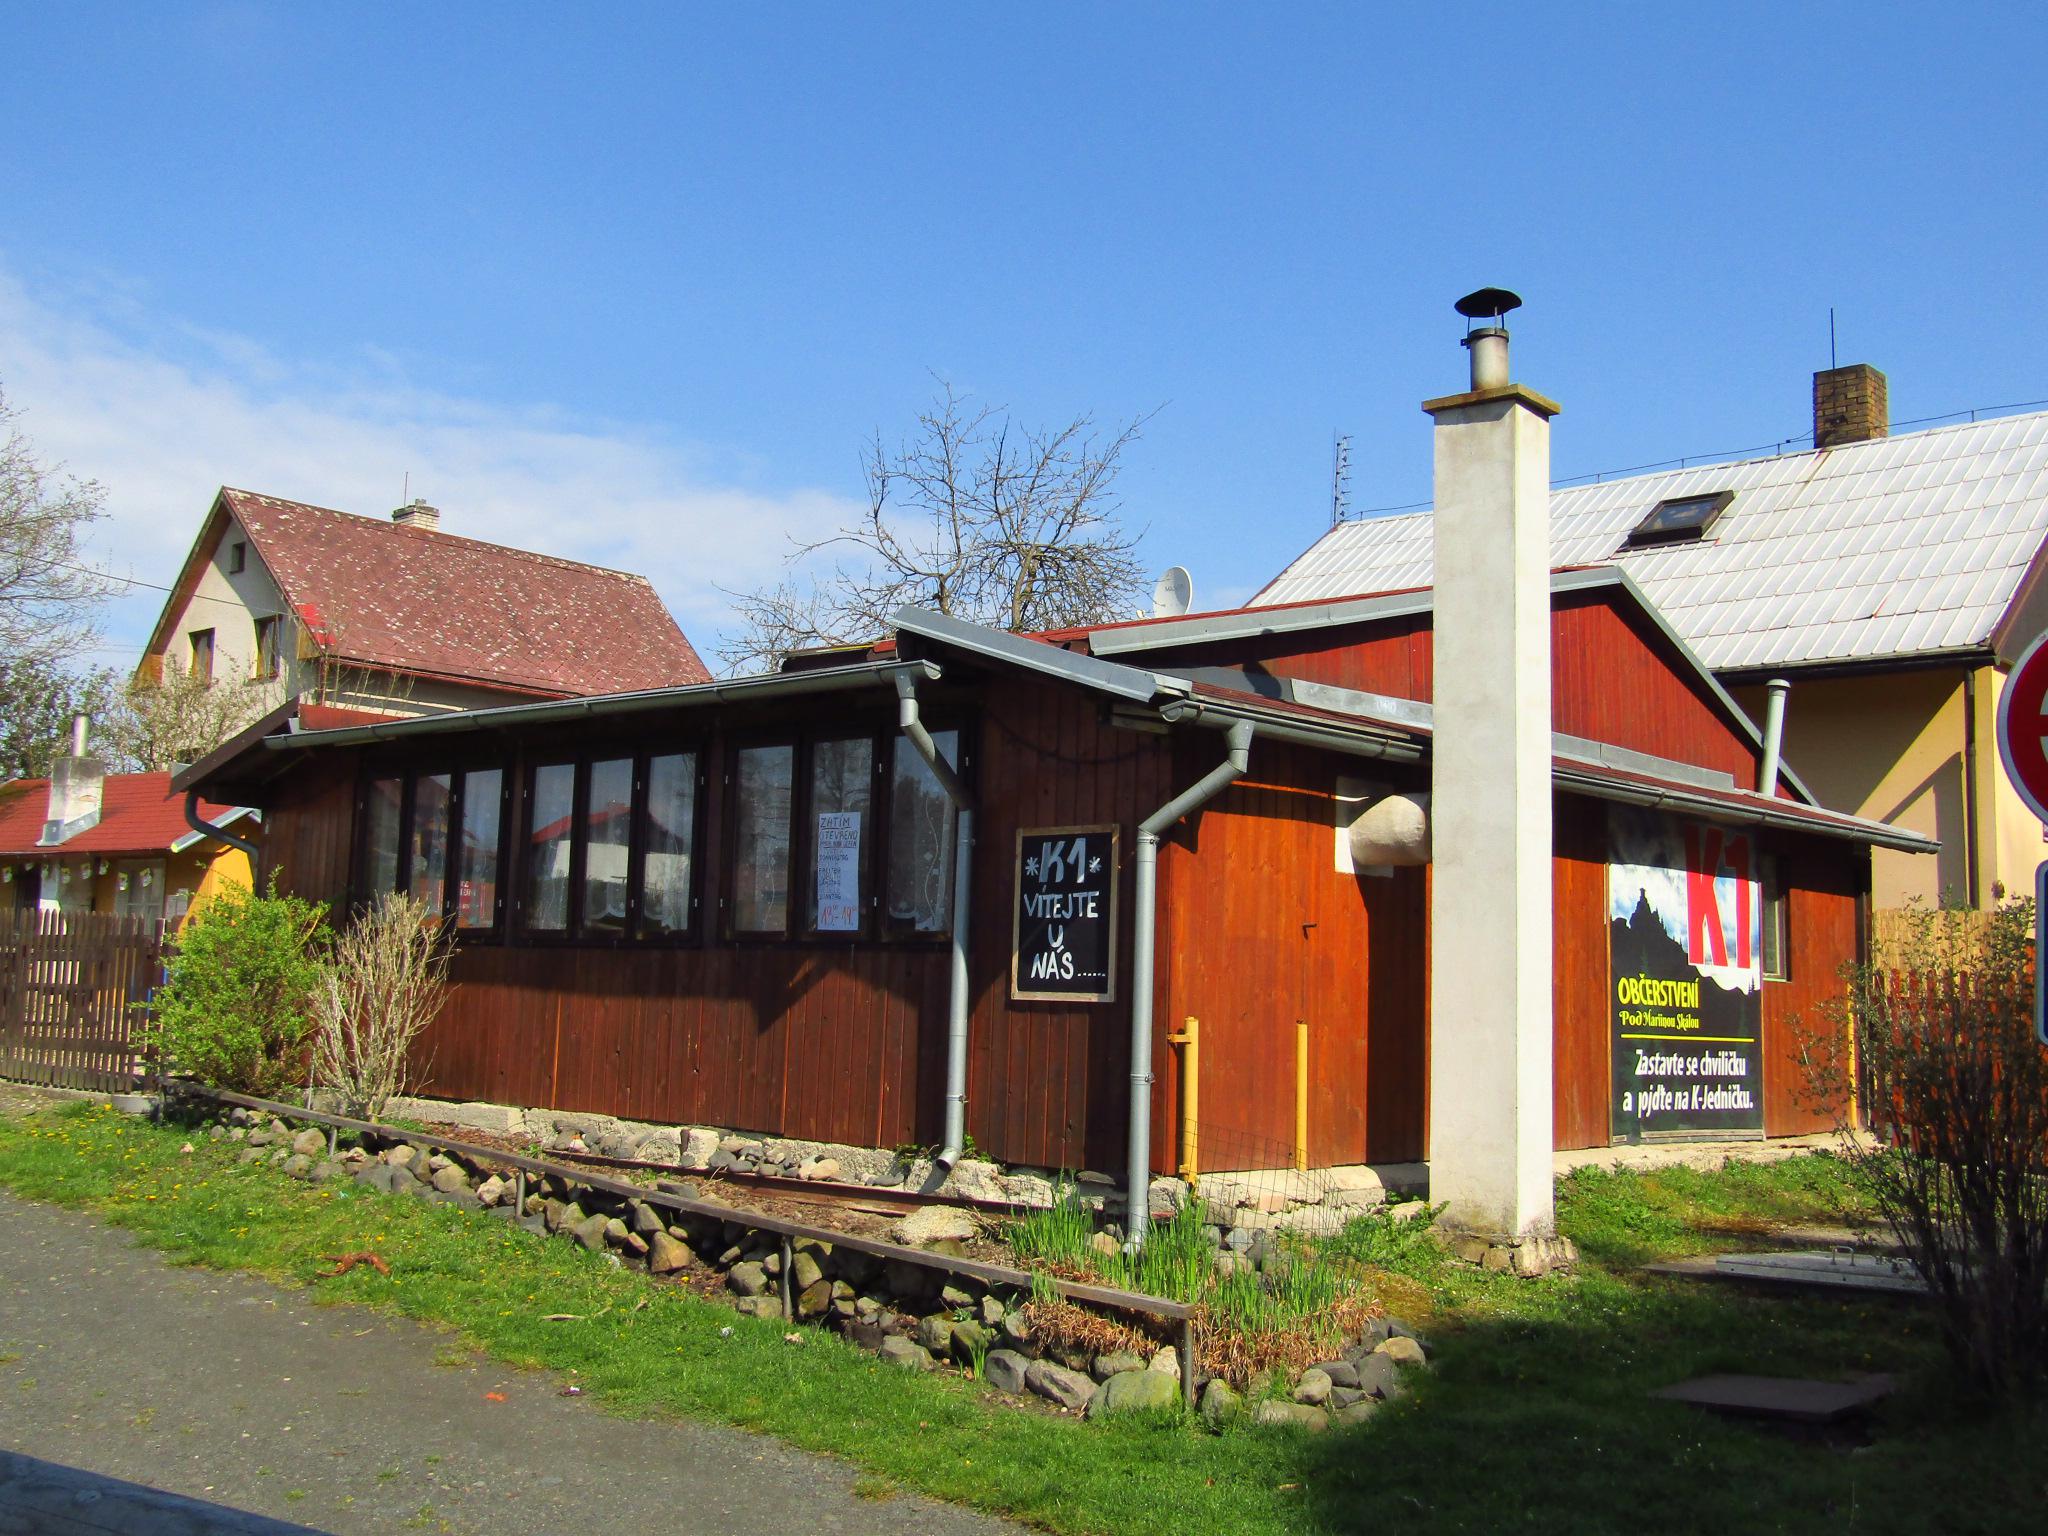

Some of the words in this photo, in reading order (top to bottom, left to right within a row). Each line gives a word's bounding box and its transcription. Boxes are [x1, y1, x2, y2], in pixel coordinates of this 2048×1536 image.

[1024, 884, 1100, 919] VÍTEJTE
[1685, 823, 1751, 969] K1
[1047, 923, 1064, 948] U
[1617, 973, 1699, 1009] OBČERSTVENÍ
[1619, 1010, 1643, 1026] Pod
[1676, 1013, 1699, 1032] Skálou
[1634, 1048, 1684, 1076] Zastavte
[1686, 1056, 1698, 1076] se
[1700, 1050, 1746, 1076] chviličku
[1622, 1091, 1632, 1112] a
[1674, 1090, 1689, 1111] na
[1691, 1083, 1754, 1110] K-Jedničku.
